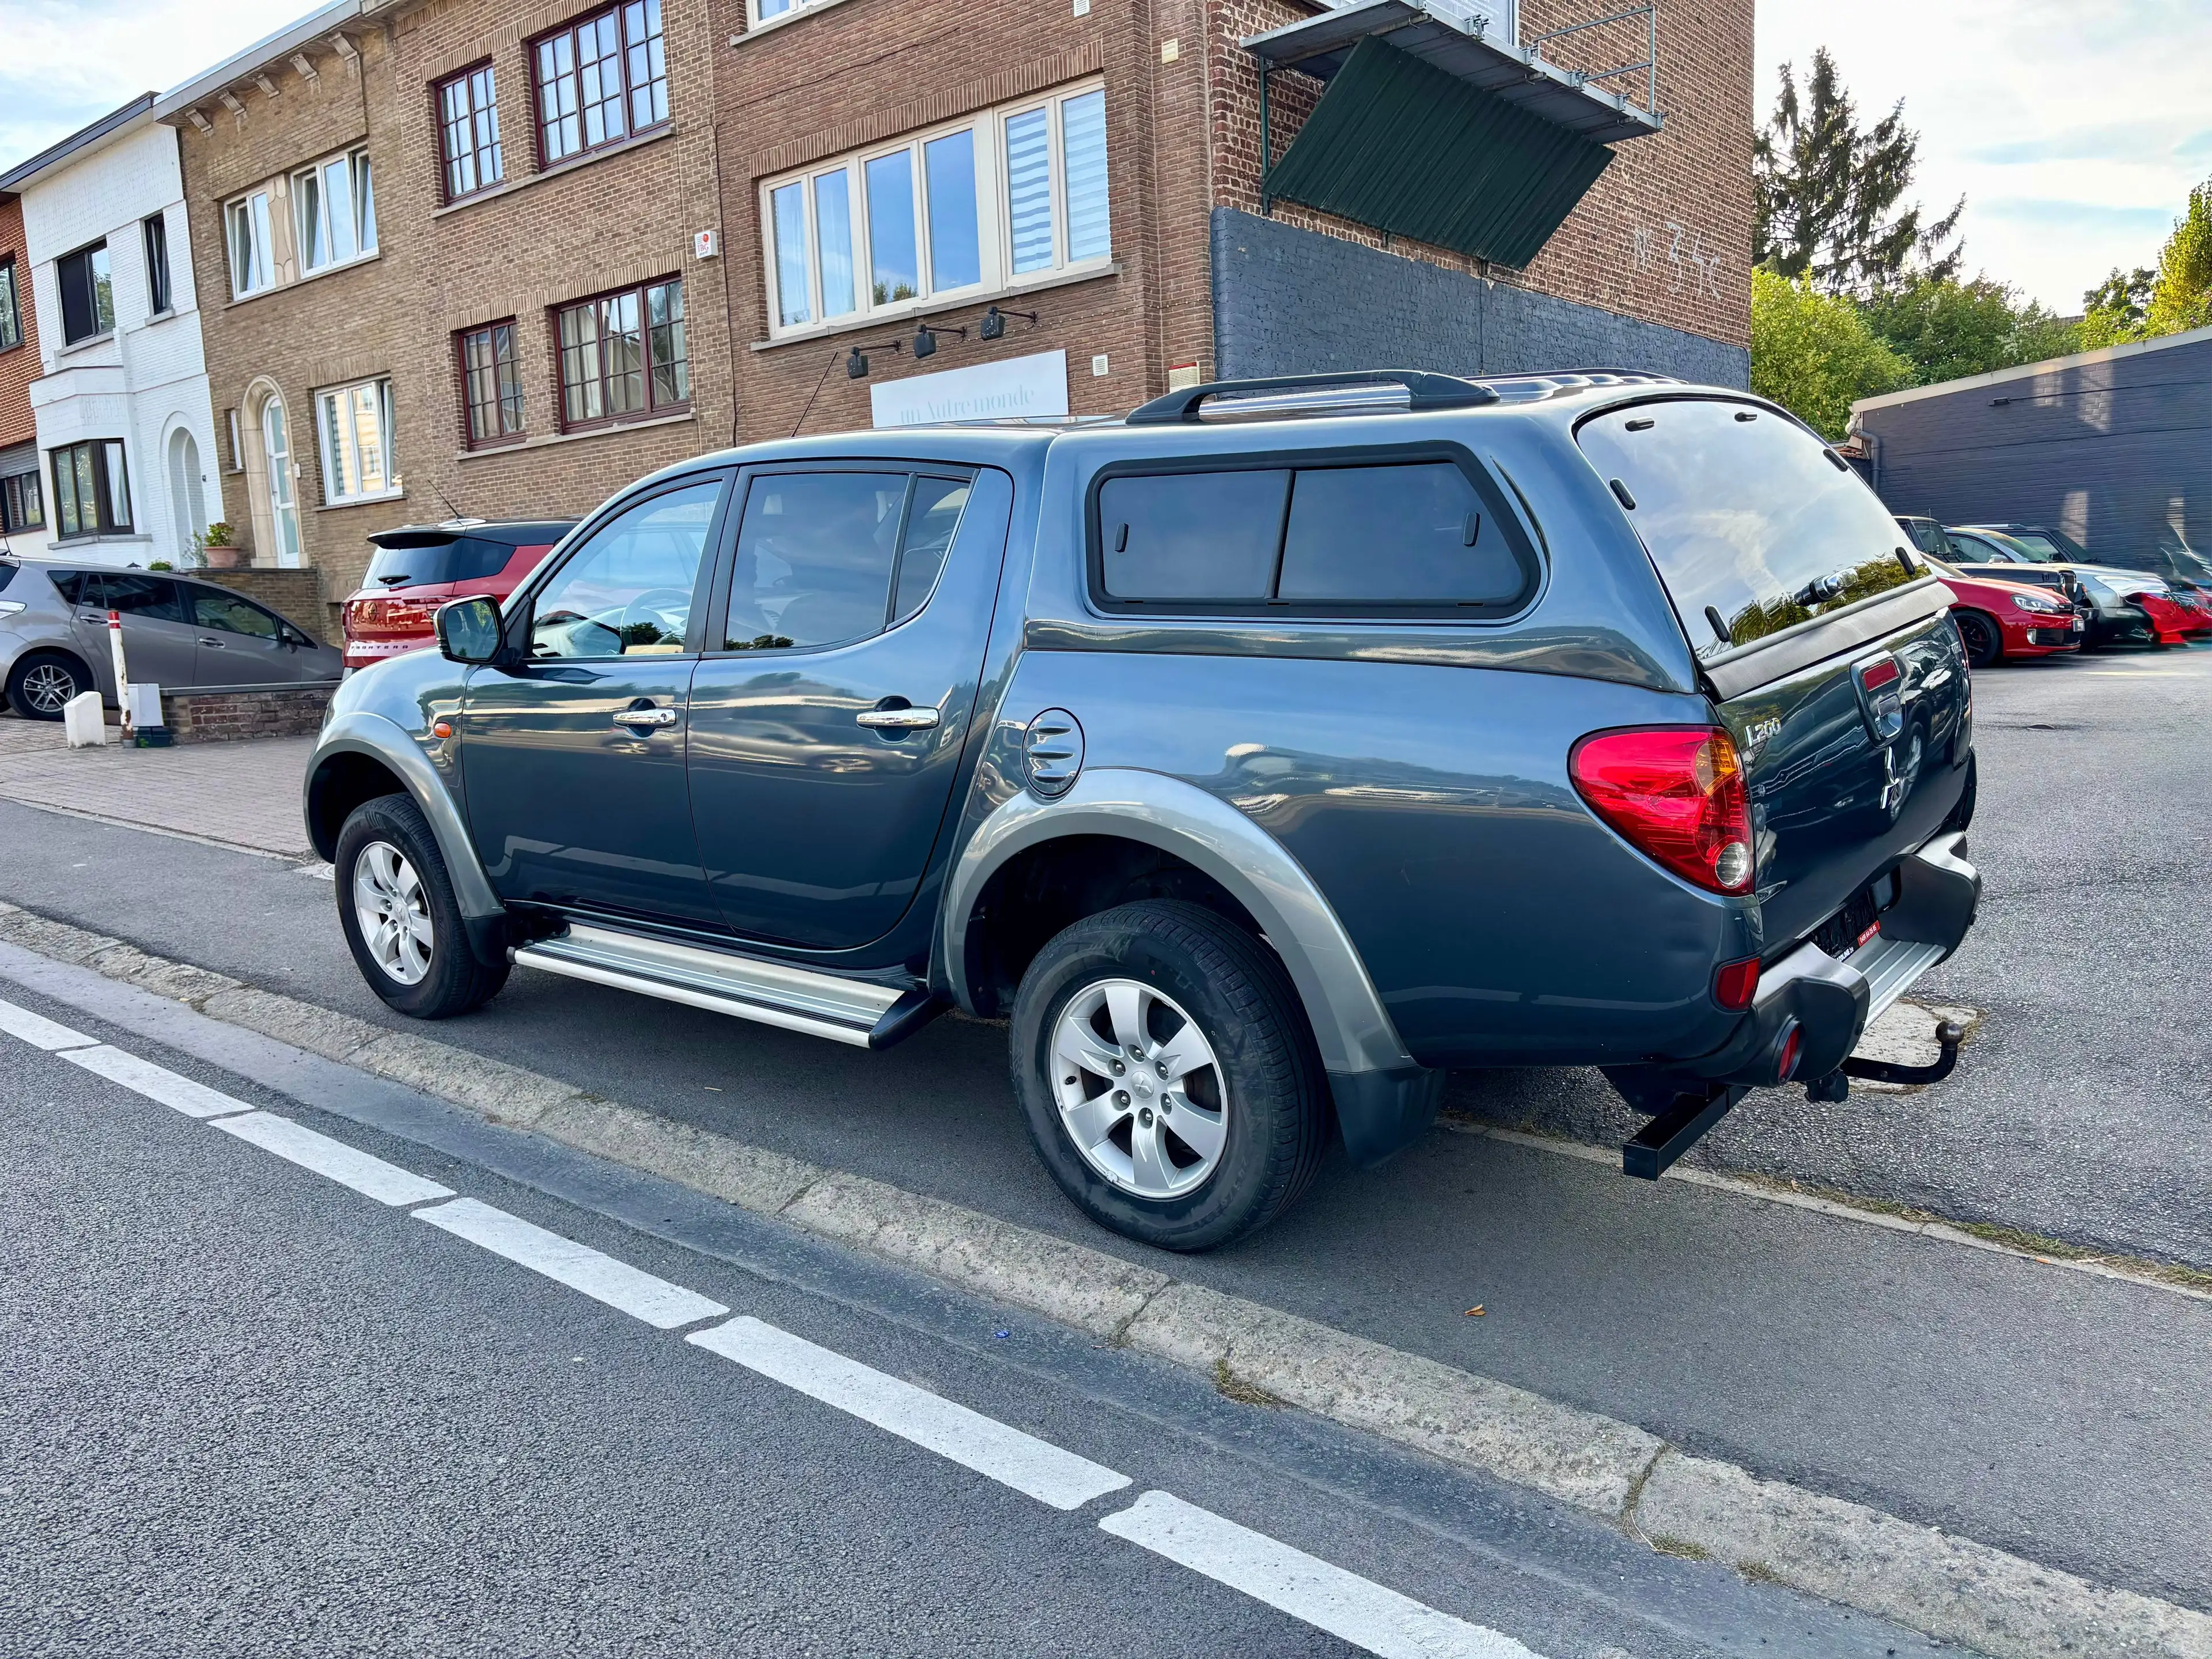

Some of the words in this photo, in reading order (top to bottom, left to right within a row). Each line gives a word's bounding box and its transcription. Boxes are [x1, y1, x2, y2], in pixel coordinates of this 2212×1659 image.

[901, 408, 921, 425] un
[974, 384, 1034, 412] monde
[1744, 717, 1781, 747] L200
